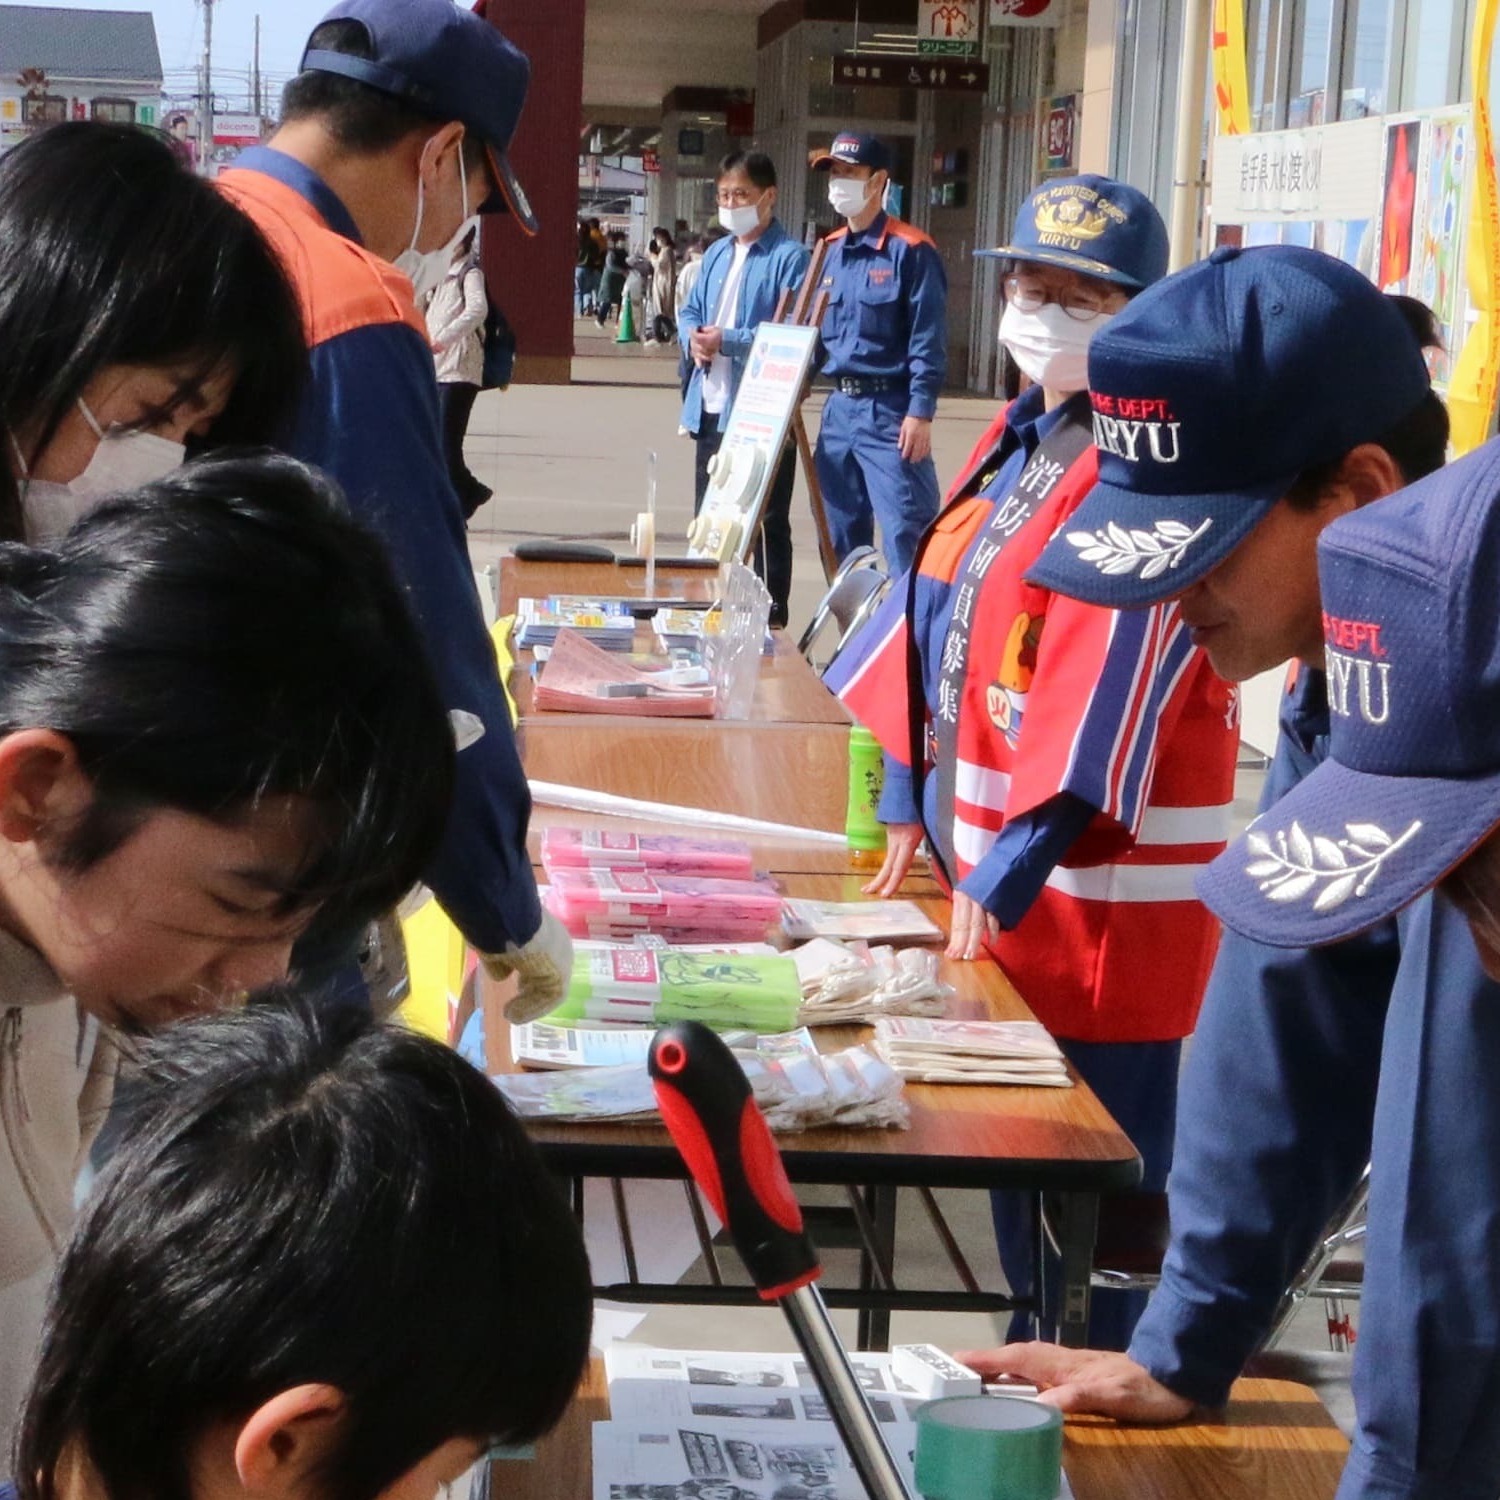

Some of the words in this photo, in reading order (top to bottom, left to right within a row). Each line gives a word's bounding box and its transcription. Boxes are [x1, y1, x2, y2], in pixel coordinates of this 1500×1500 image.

[922, 42, 973, 55] クリーニング
[216, 120, 256, 132] docomo
[1038, 231, 1082, 251] KIRYU
[1117, 397, 1176, 420] DEPT.
[937, 453, 1065, 725] 消防団員募集
[1324, 643, 1393, 724] RYU
